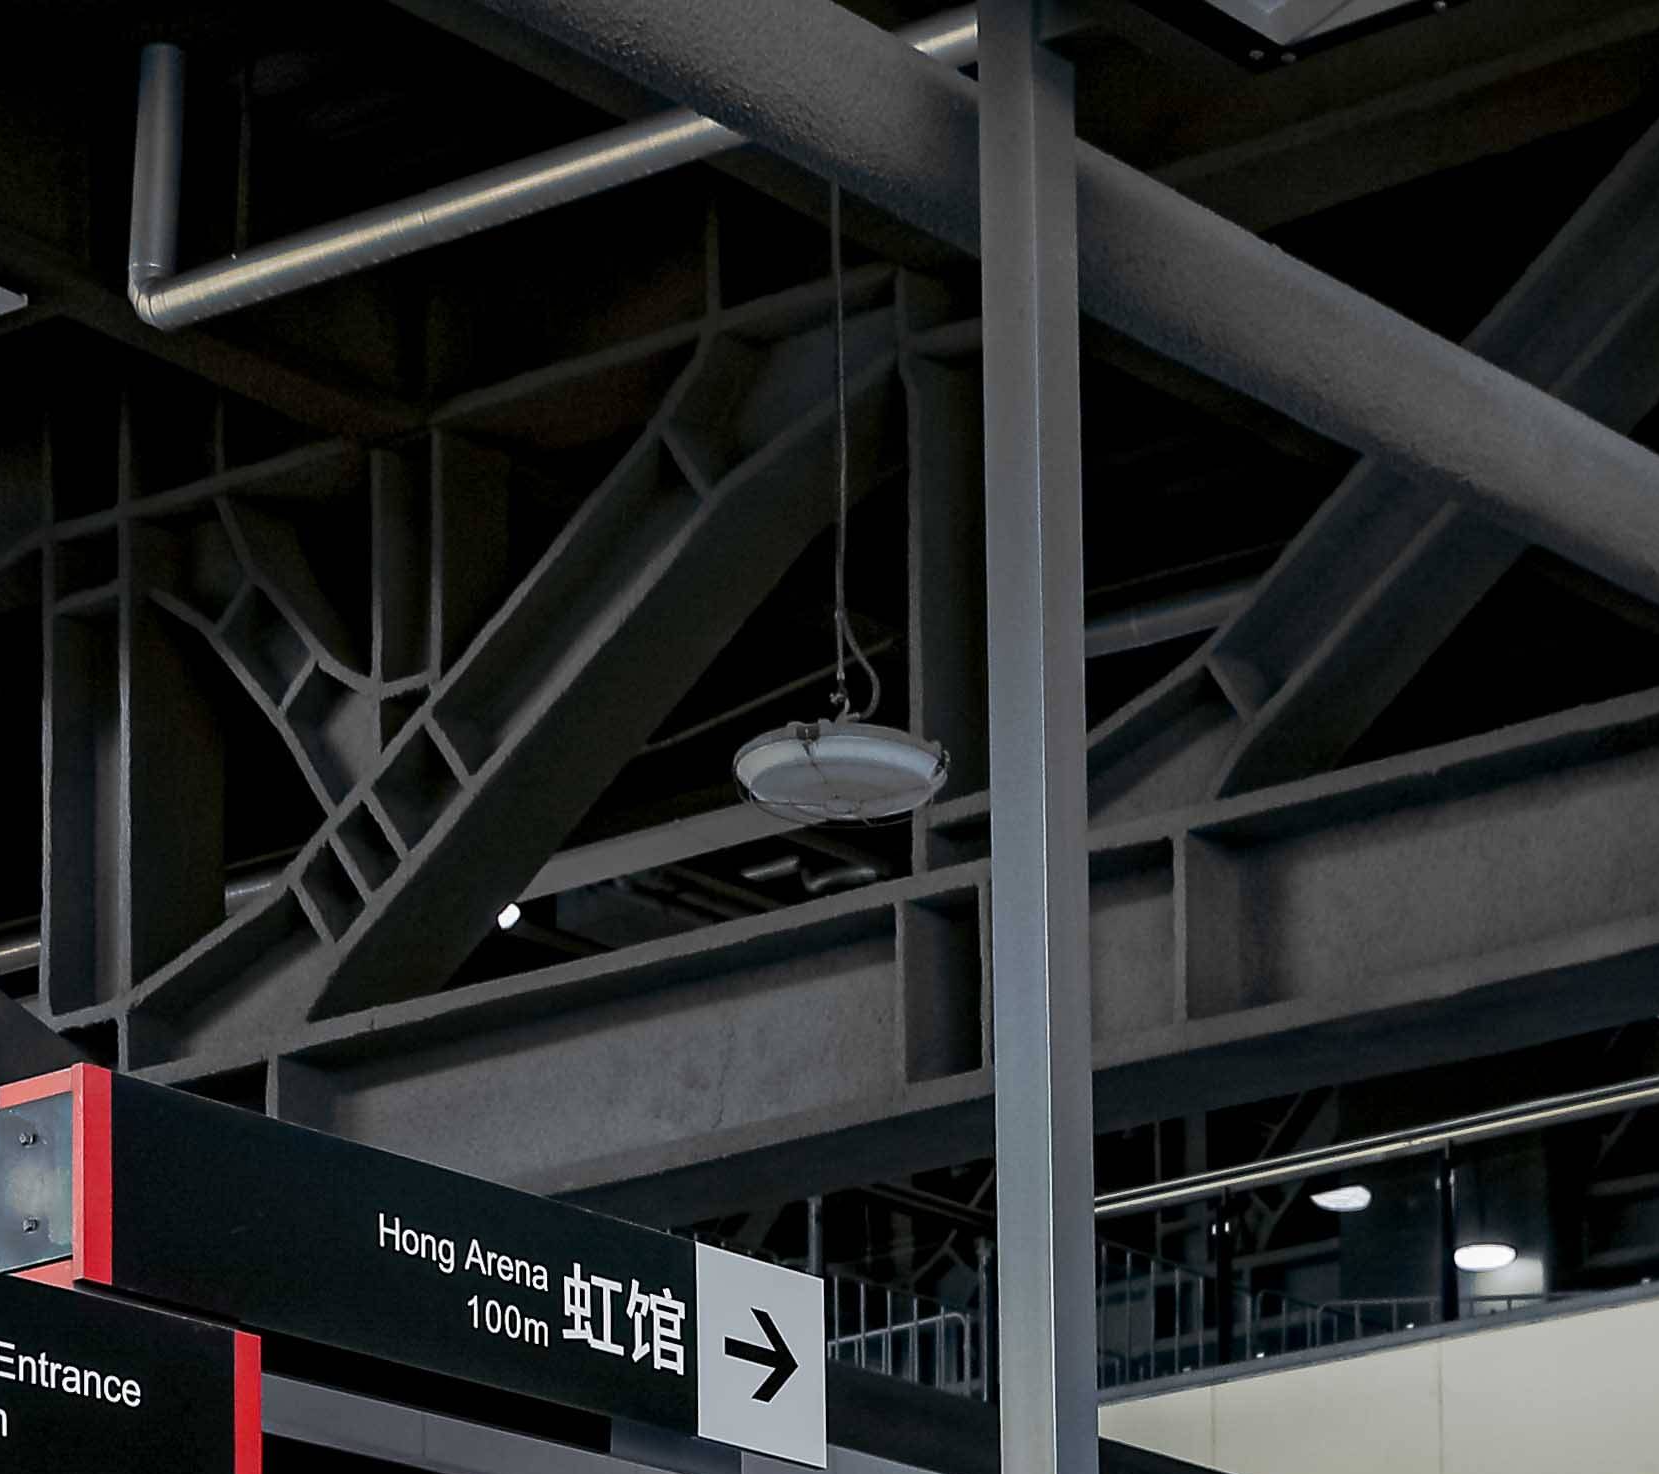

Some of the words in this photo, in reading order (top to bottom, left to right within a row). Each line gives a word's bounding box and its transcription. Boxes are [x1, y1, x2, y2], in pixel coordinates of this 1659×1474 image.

[379, 1212, 455, 1274] Hong
[464, 1238, 549, 1292] Arena
[467, 1294, 549, 1348] 100m
[562, 1262, 686, 1376] 虹馆
